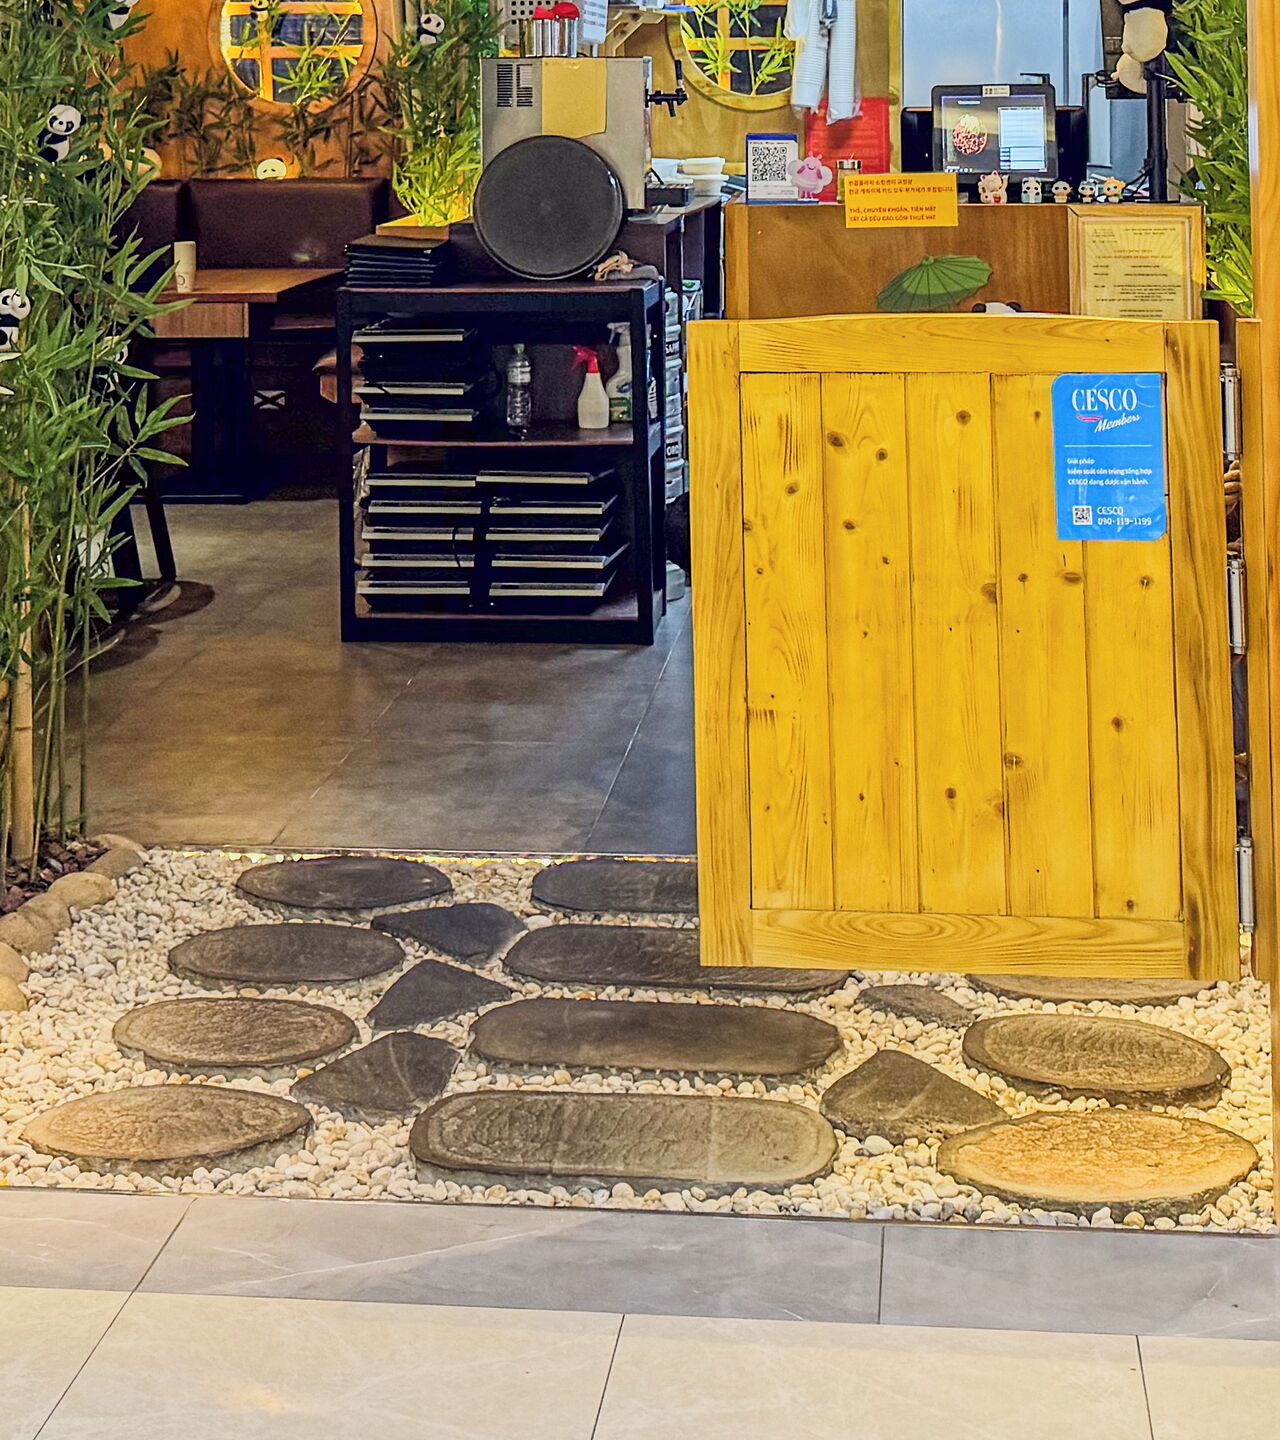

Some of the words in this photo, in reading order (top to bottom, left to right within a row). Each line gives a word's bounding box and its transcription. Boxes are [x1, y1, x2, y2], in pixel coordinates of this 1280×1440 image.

[1072, 388, 1138, 411] CESCO
[1094, 412, 1140, 433] Members
[1097, 506, 1124, 515] CESCO
